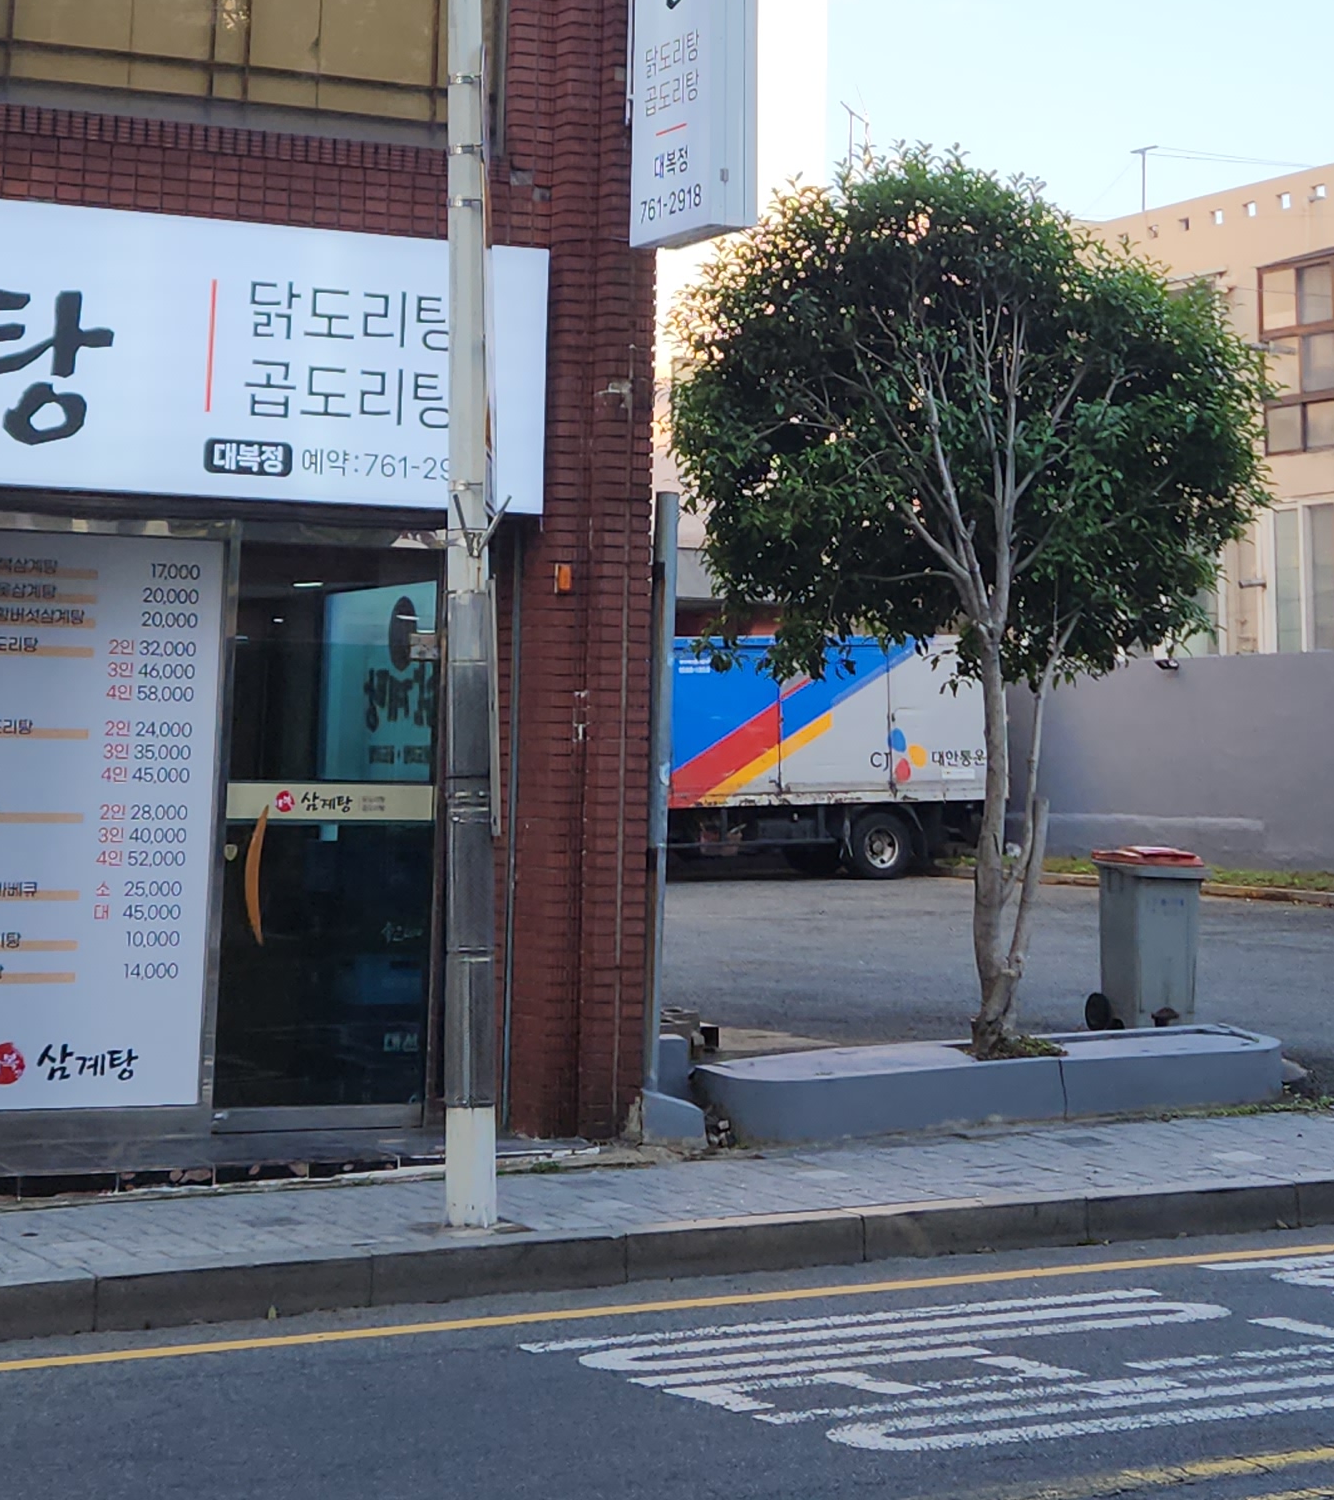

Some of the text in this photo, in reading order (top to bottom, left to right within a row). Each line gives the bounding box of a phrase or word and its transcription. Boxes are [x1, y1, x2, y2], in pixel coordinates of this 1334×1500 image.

[644, 28, 700, 79] 닭도리탕
[643, 68, 700, 118] 곱도리탕
[653, 145, 689, 179] 대복정
[639, 183, 703, 225] 761-2918
[212, 442, 285, 474] 대복정
[150, 562, 201, 581] 17,000
[142, 586, 199, 605] 20,000
[140, 611, 198, 629] 20,000
[108, 638, 134, 656] 2인
[139, 639, 196, 658] 32,000
[107, 661, 195, 680] 3인 46,000
[105, 684, 194, 703] 4인 58,000
[104, 720, 131, 738] 2인
[135, 721, 192, 739] 24,000
[102, 743, 191, 761] 3인 35,000
[869, 751, 891, 772] CJ
[101, 766, 190, 784] 4인 45,000
[99, 803, 126, 821] 2인
[130, 804, 188, 821] 28,000
[98, 827, 187, 845] 3인 40,000
[95, 850, 186, 868] 4인 52,000
[95, 882, 111, 897] 소
[123, 880, 182, 898] 25,000
[93, 904, 181, 922] 대 45,000
[125, 930, 181, 948] 10,000
[123, 963, 179, 980] 14,000
[36, 1043, 140, 1081] 삼계탕
